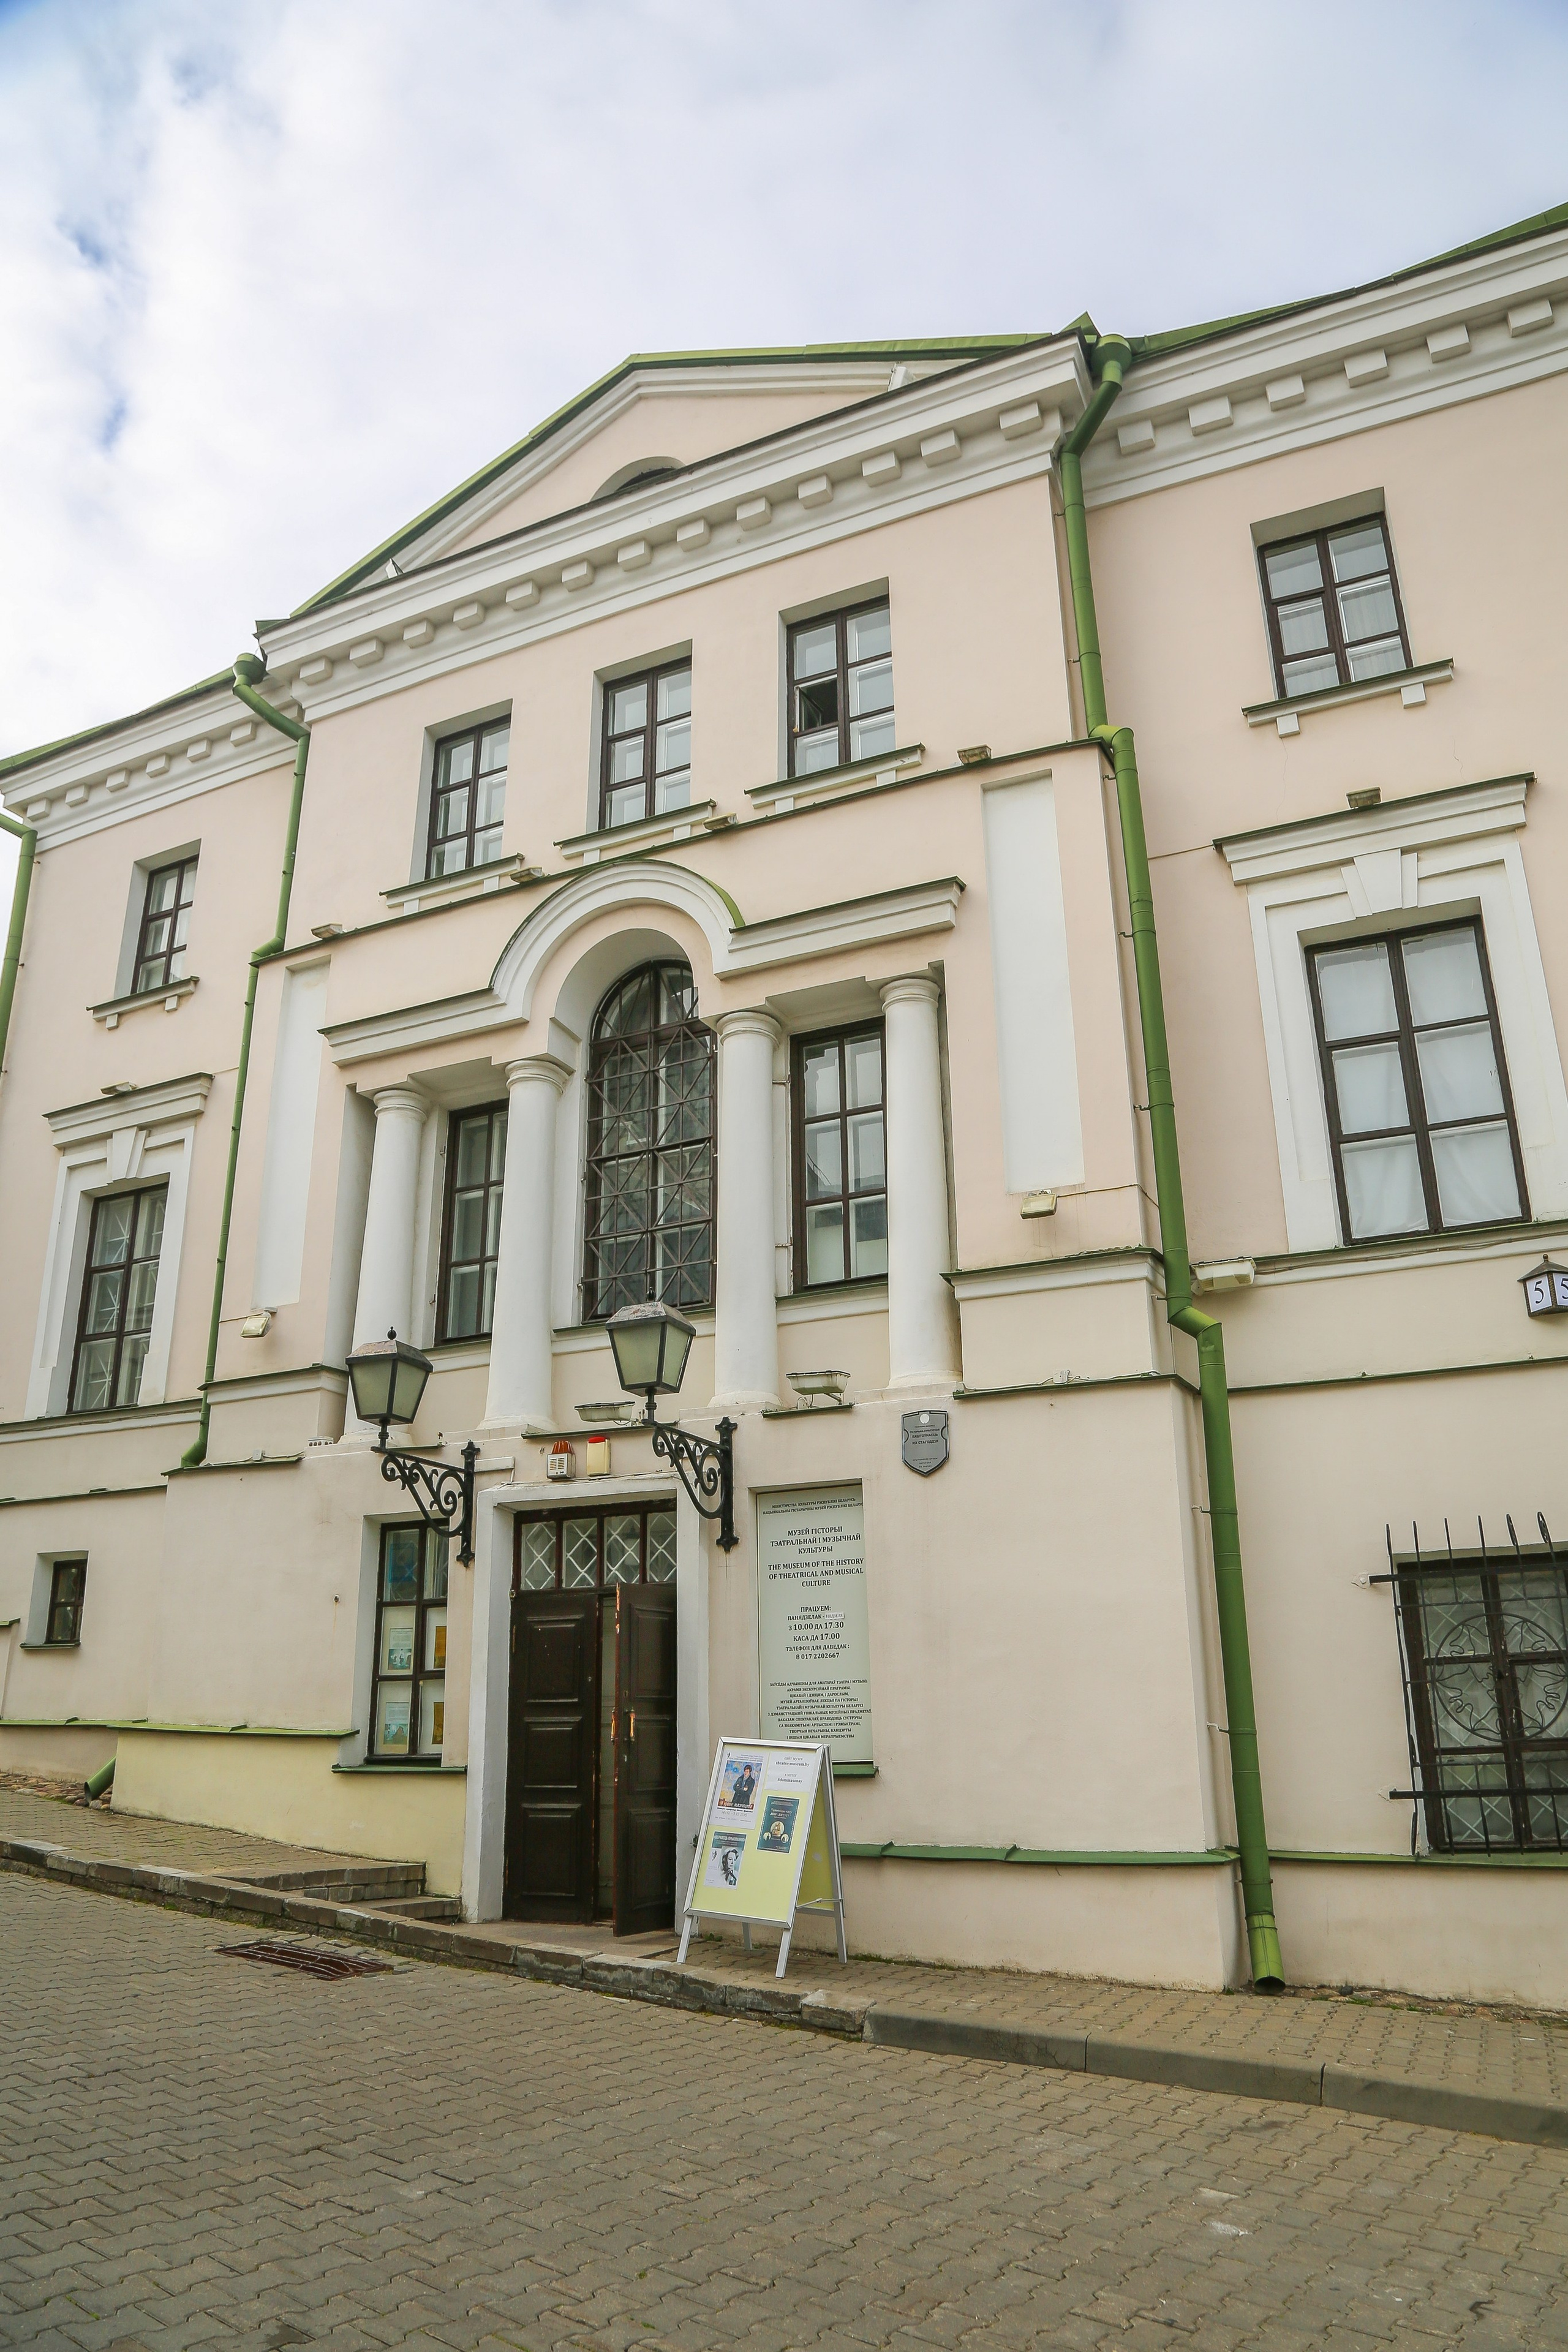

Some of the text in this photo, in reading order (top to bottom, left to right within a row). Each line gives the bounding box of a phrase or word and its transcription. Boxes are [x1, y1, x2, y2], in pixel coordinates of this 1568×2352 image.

[1534, 1280, 1544, 1303] 5
[1561, 1278, 1568, 1299] 5
[788, 1526, 843, 1536] МУЗЕЙ ГІСТОРЫІ
[771, 1536, 817, 1547] ТЭАТРАЛЬНАЙ
[822, 1533, 861, 1543] МУЗЫЧНАЙ
